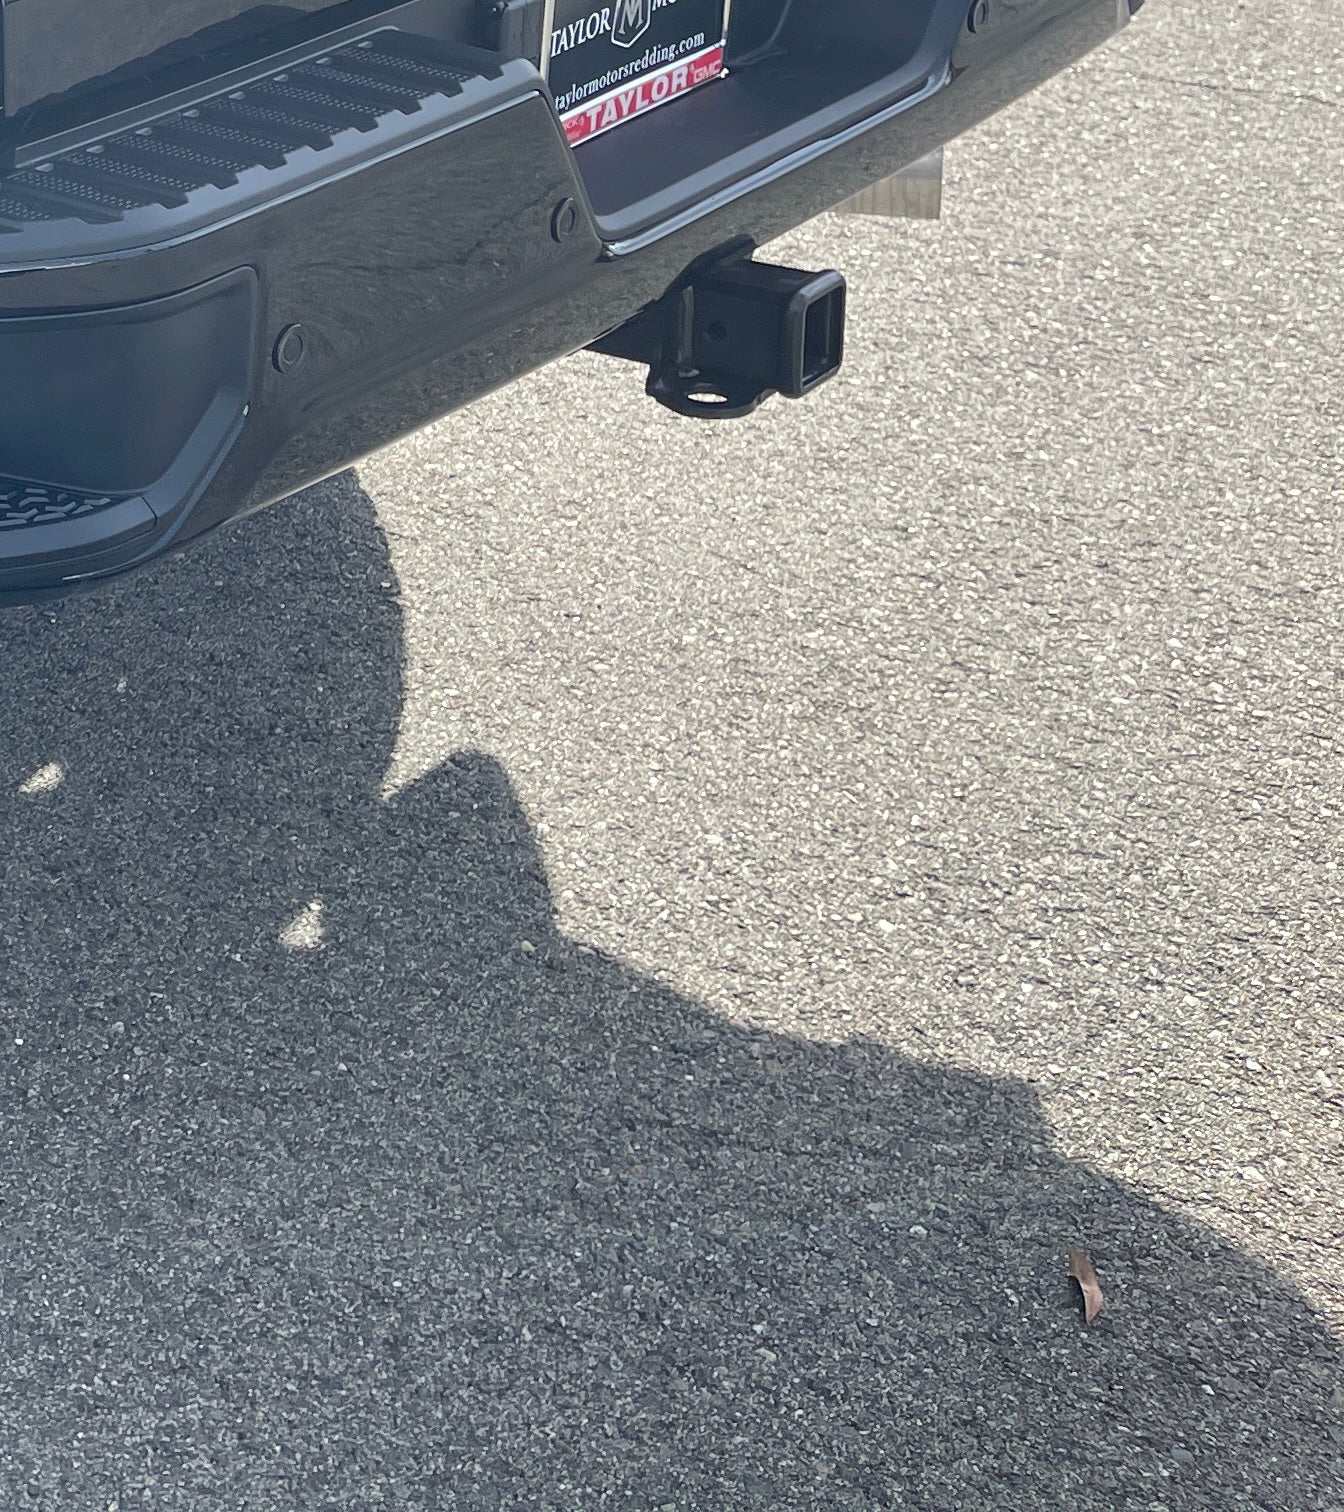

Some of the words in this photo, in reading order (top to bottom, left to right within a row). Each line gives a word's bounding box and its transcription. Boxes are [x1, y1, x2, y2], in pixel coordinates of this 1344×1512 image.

[551, 7, 612, 57] TAYLOR
[555, 31, 705, 111] taylormotorsredding.com
[586, 65, 688, 133] TAYLOR
[693, 59, 722, 83] GMC
